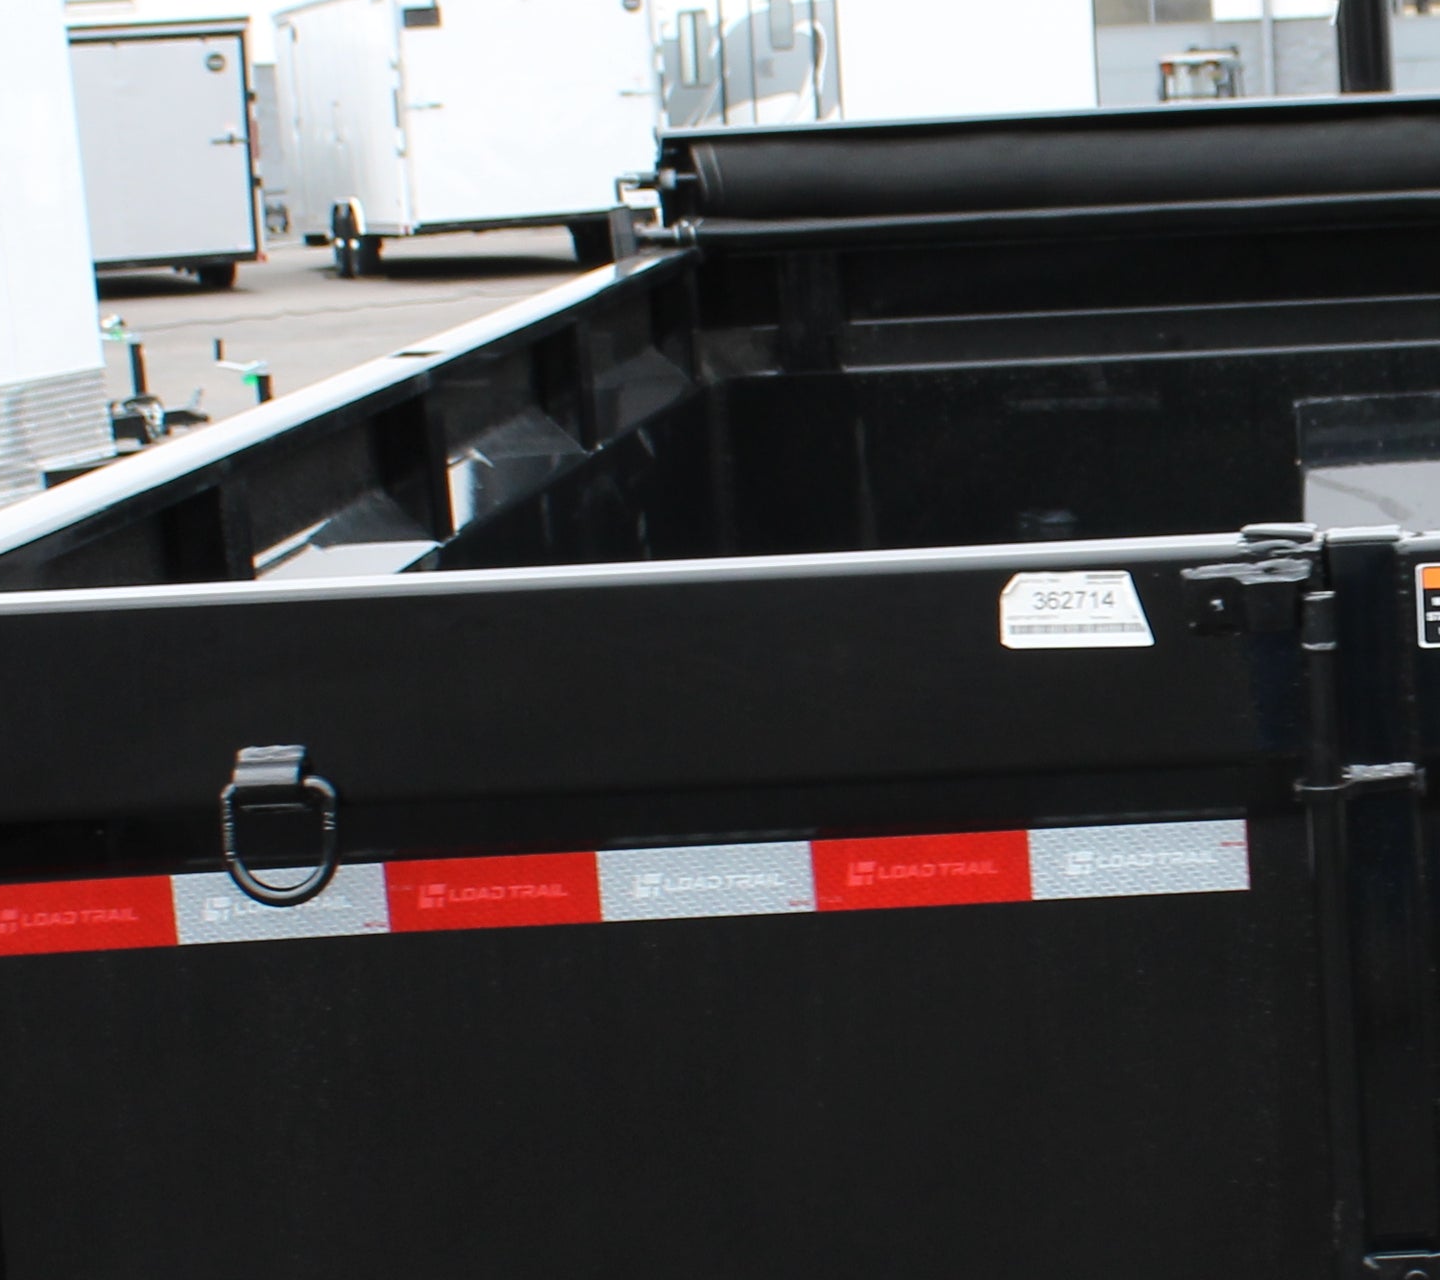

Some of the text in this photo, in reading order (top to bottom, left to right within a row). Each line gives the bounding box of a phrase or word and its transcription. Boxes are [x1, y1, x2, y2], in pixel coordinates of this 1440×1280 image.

[1033, 590, 1115, 610] 362714
[877, 859, 999, 880] LOAD TRAIL
[448, 883, 568, 903] LOAD TRAIL
[21, 907, 139, 928] LOAD TRAIL
